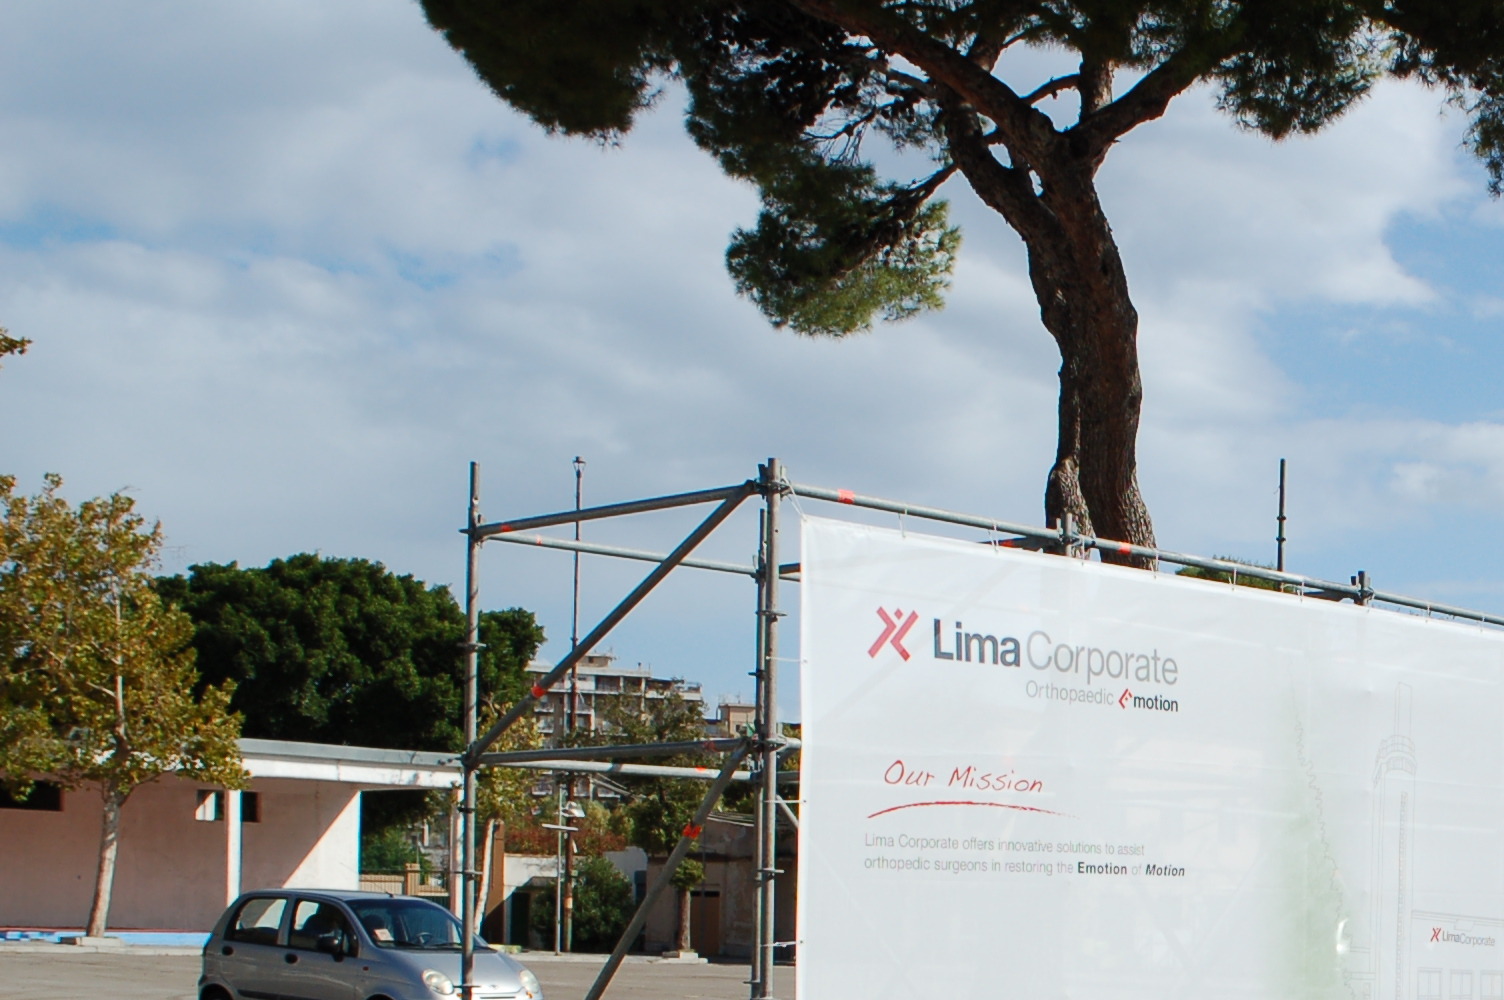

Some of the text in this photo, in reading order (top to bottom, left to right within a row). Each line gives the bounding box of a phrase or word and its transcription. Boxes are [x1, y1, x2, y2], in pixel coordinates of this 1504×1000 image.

[1026, 680, 1115, 706] Orthopaedic
[884, 760, 1044, 793] Our Mission
[865, 833, 1145, 856] Lima Corporate offers innovative solutions to assist
[864, 856, 930, 874] orthopedic
[934, 859, 988, 876] surgeons
[991, 859, 1001, 872] in
[1004, 861, 1053, 877] restoring
[1056, 861, 1074, 873] the
[1078, 862, 1127, 875] Emotion
[1145, 863, 1185, 877] Motion
